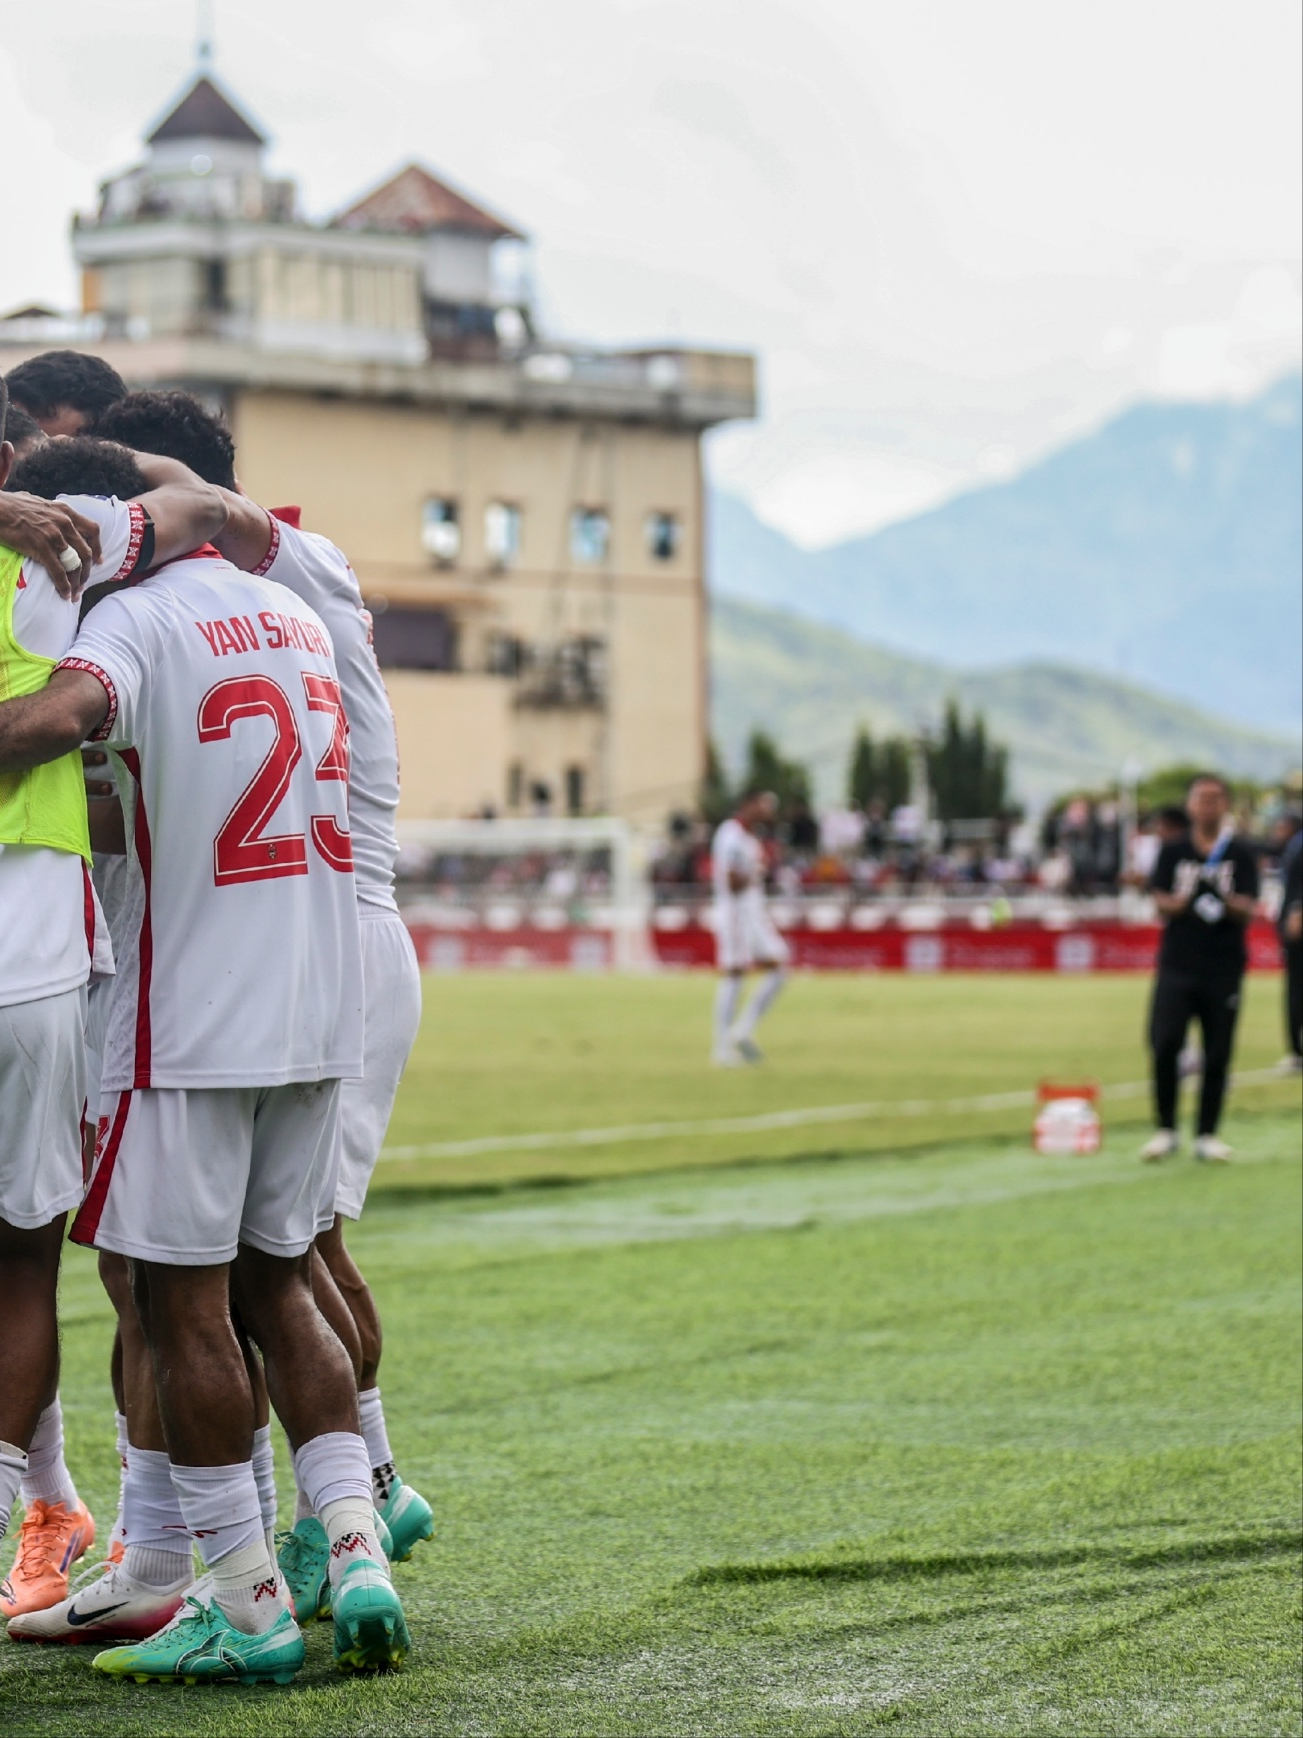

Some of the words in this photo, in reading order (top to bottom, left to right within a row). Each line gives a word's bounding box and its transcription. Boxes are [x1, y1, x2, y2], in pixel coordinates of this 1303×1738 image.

[195, 615, 260, 657] YAN
[257, 610, 330, 658] SAYURI
[198, 671, 354, 887] 23
